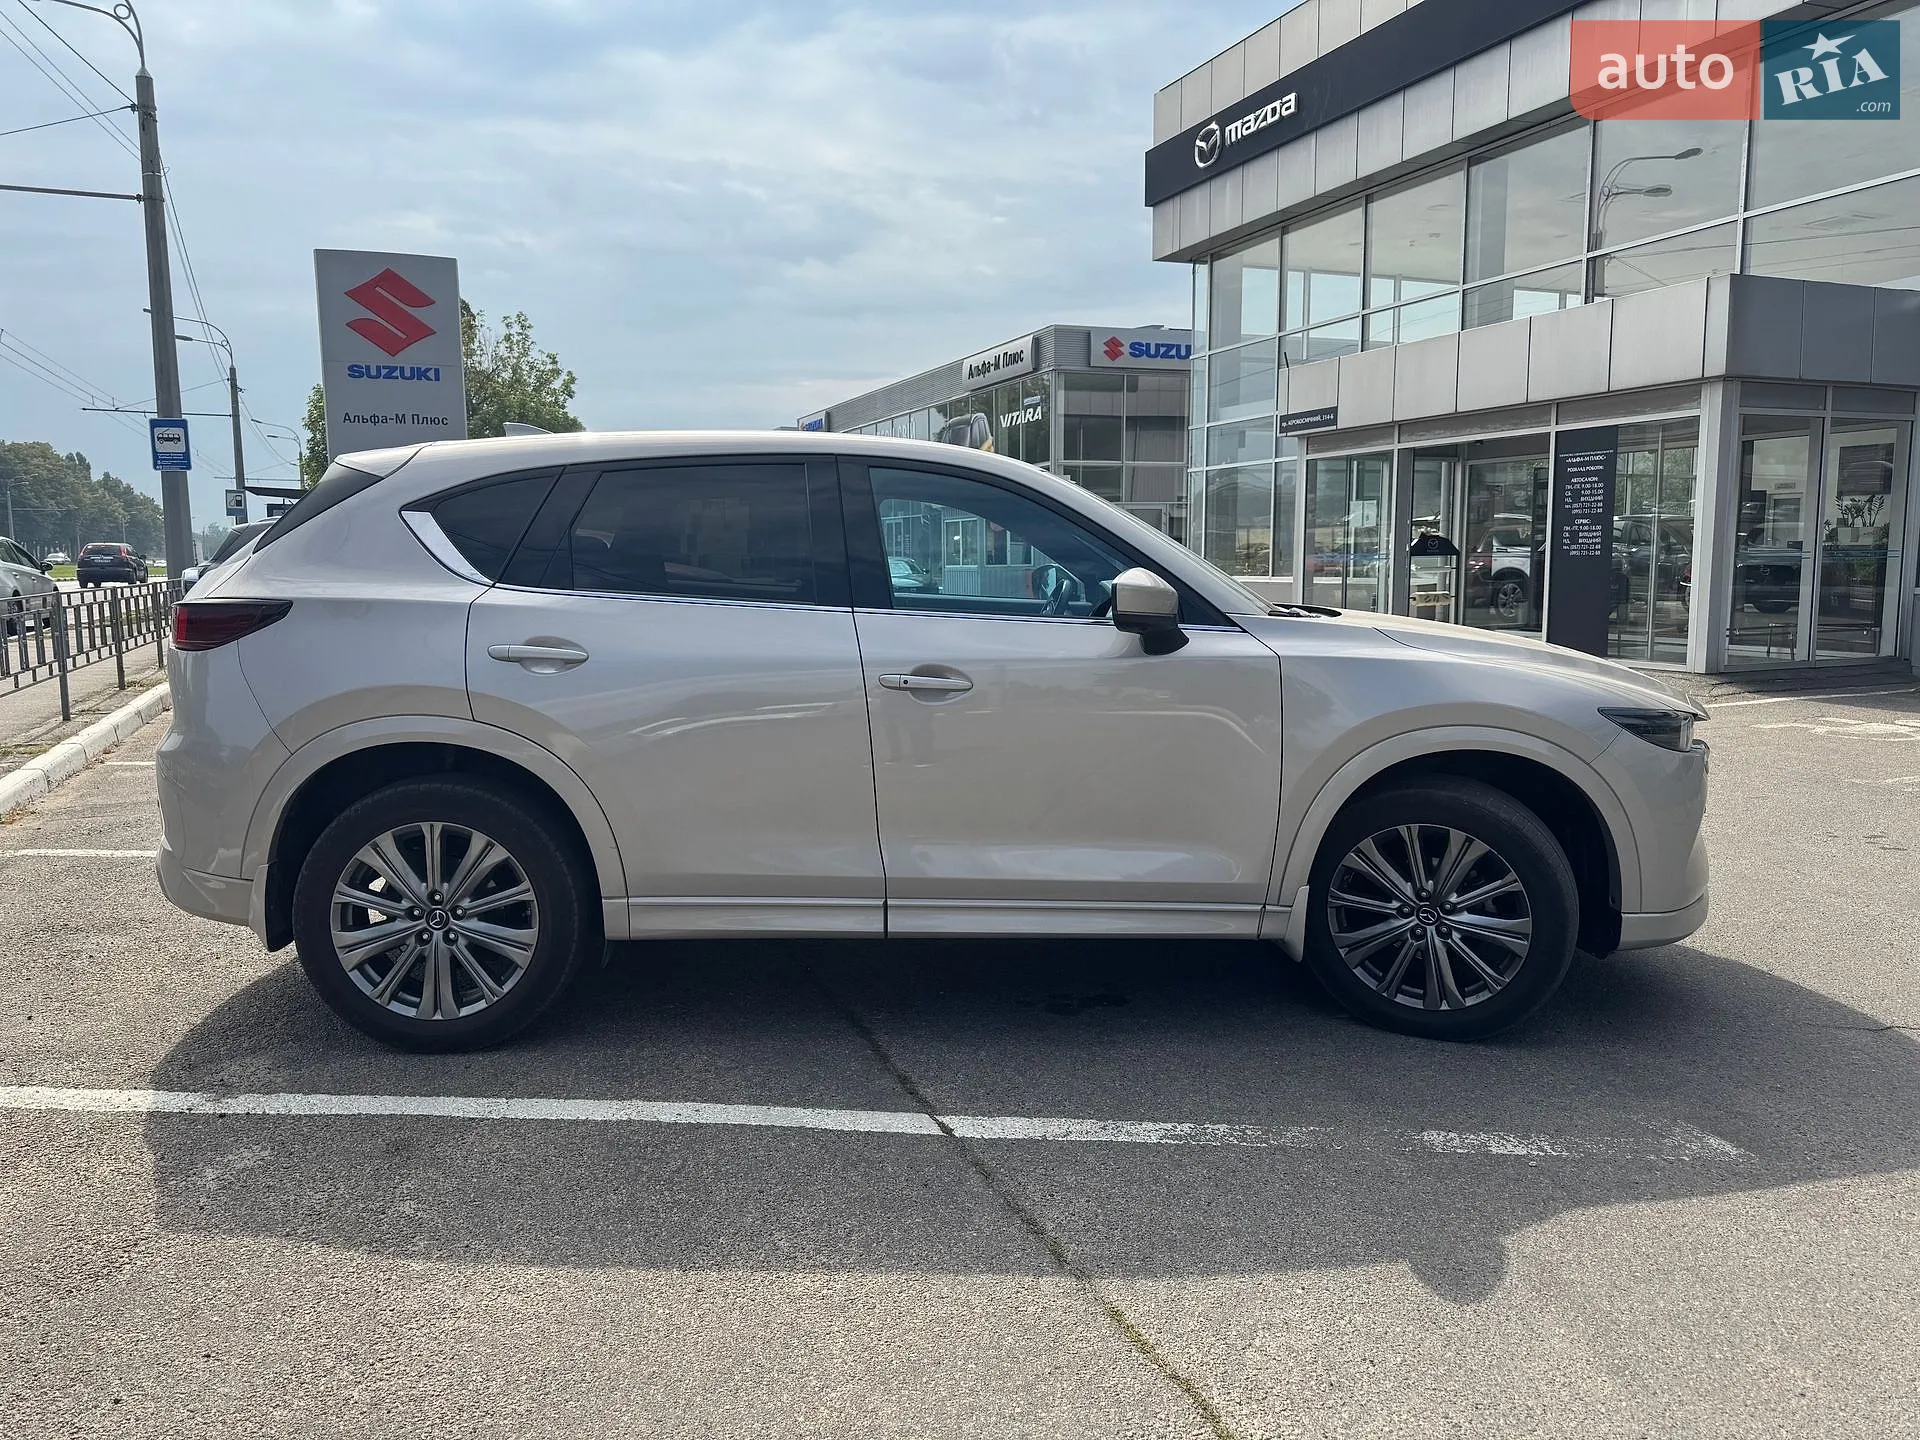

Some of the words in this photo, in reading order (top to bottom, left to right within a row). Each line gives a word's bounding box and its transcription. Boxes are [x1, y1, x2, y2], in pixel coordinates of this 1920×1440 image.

[1225, 93, 1297, 147] mazda
[347, 364, 440, 381] SUZUKI
[968, 353, 1001, 380] Альфа-М
[1002, 349, 1025, 368] Плюс
[343, 412, 406, 426] Альфа-М
[411, 413, 449, 426] Плюс
[1000, 406, 1042, 428] VITARA
